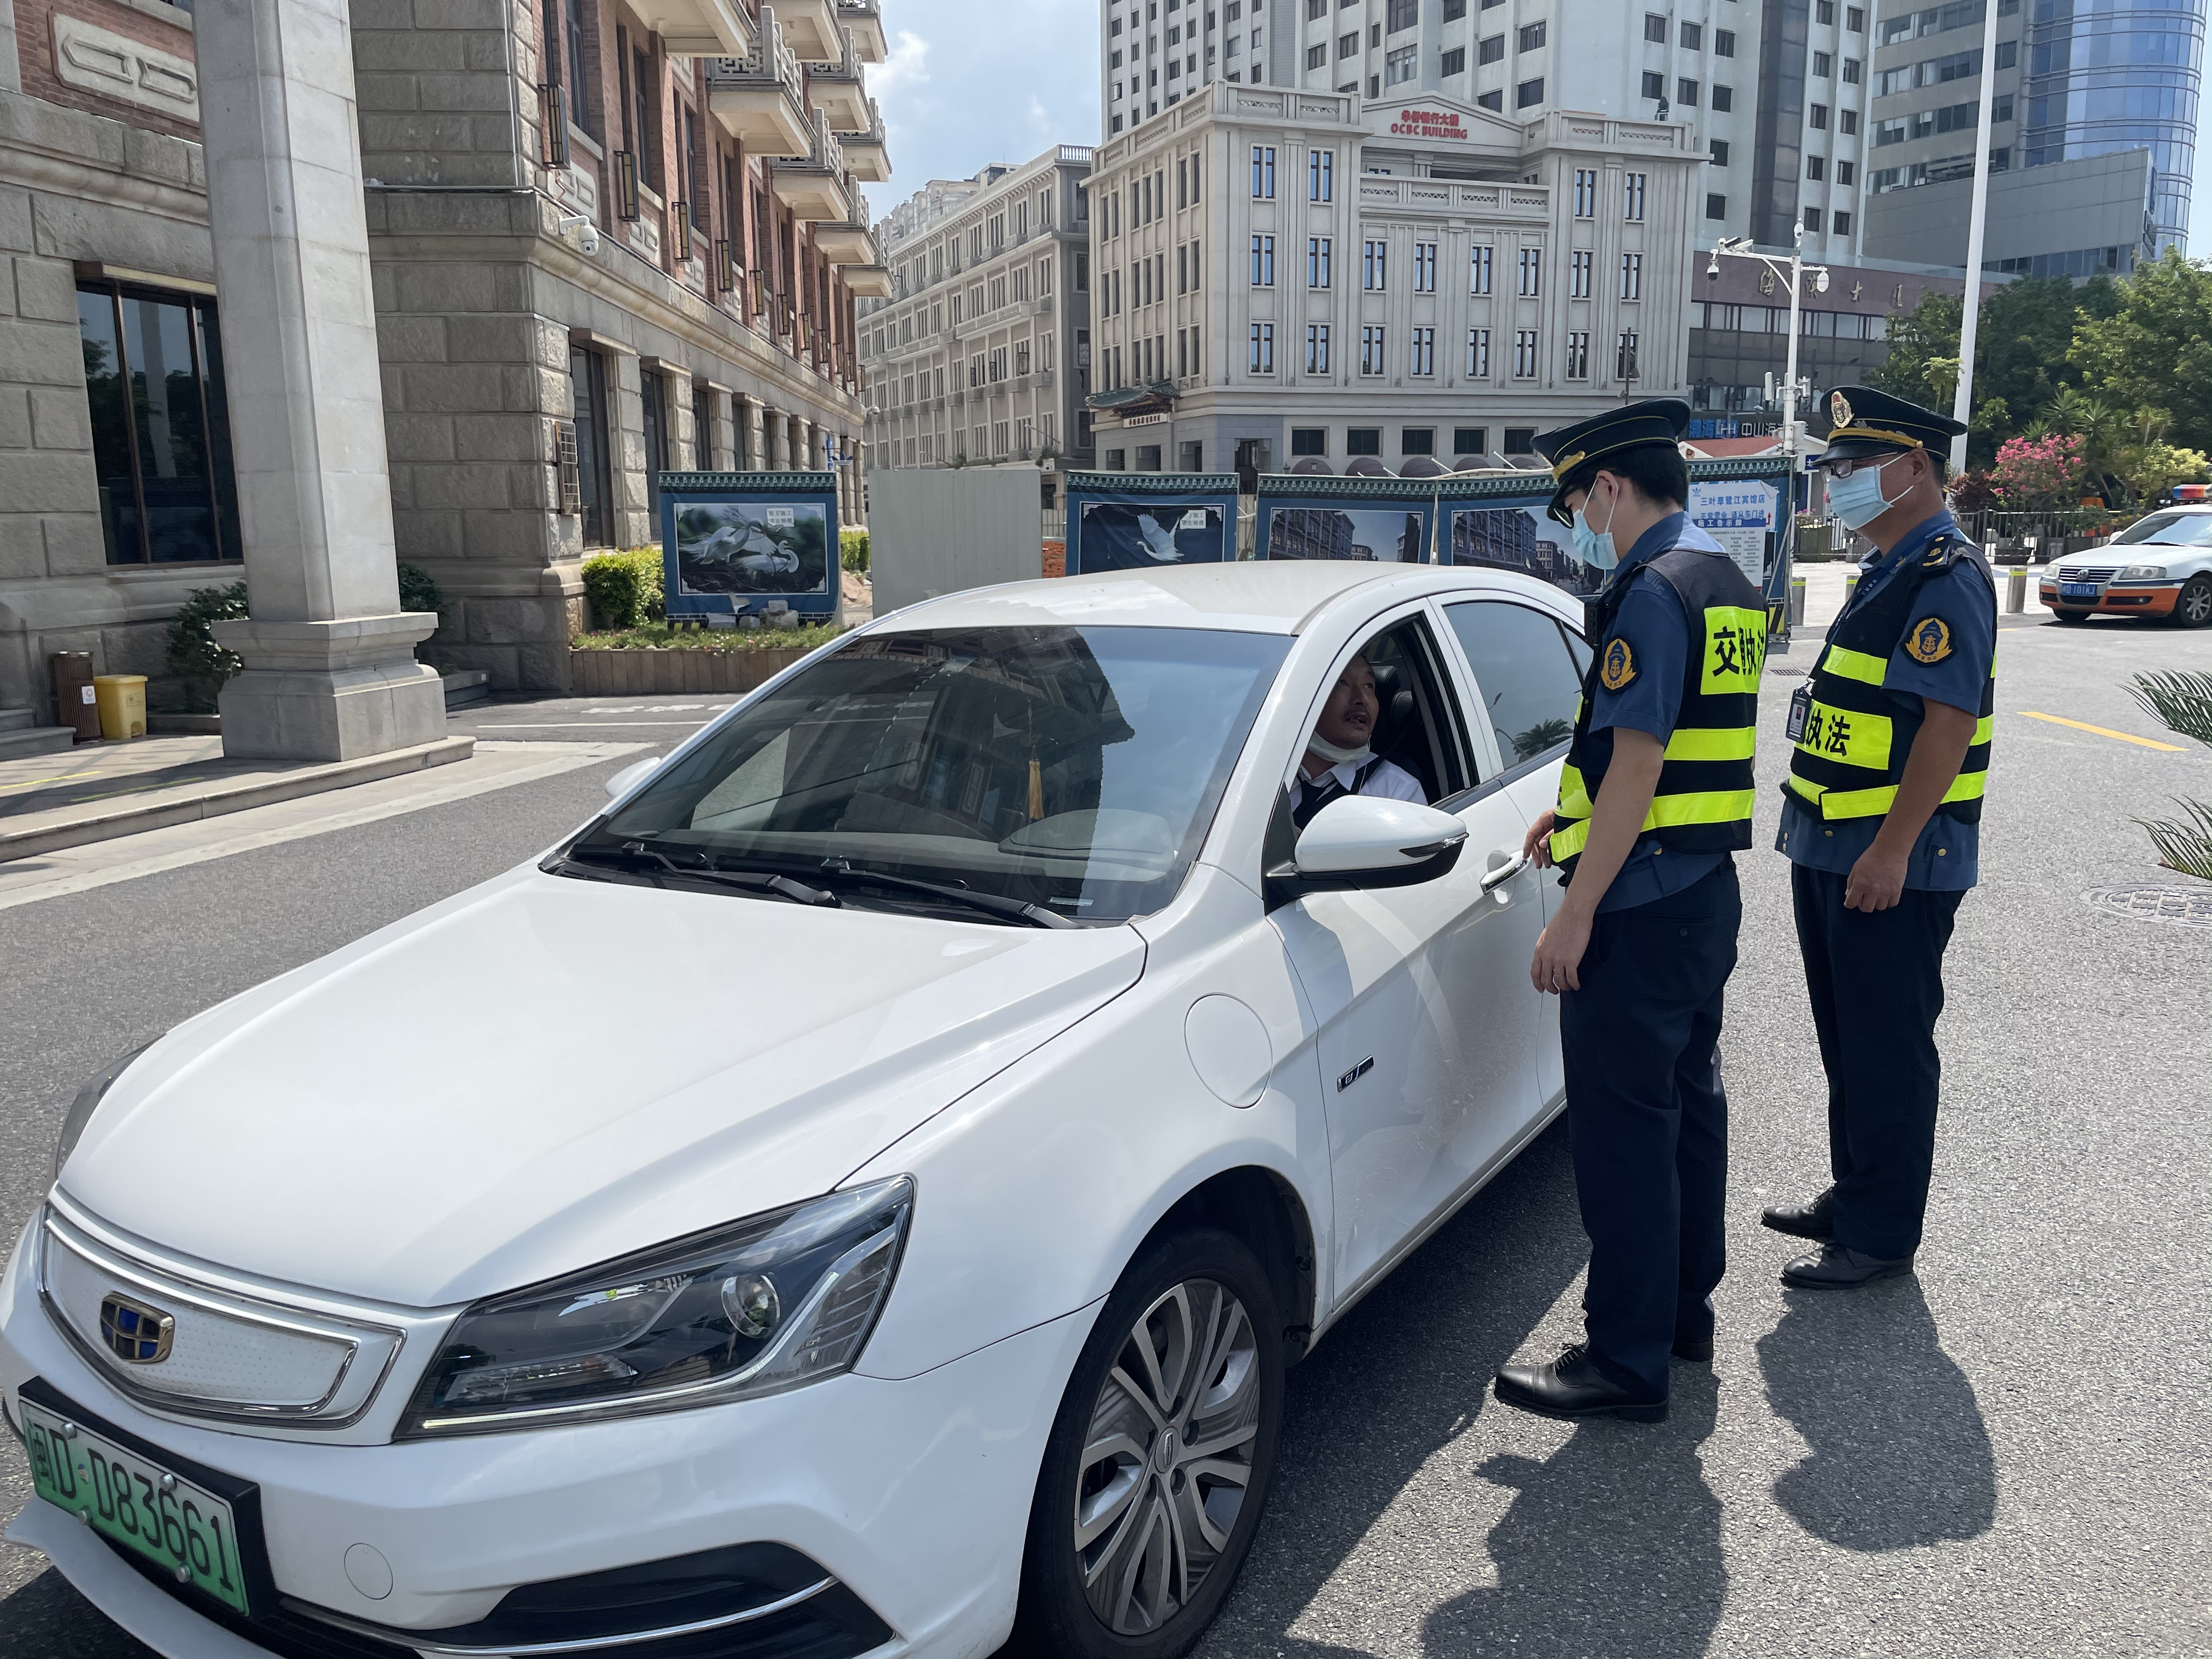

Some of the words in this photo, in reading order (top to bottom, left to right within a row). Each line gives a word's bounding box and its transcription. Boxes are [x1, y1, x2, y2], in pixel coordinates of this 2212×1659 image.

[1391, 123, 1420, 135] OCBC
[1422, 126, 1468, 139] BUILDING
[1700, 494, 1765, 506] 三叶草鹭江宾馆店
